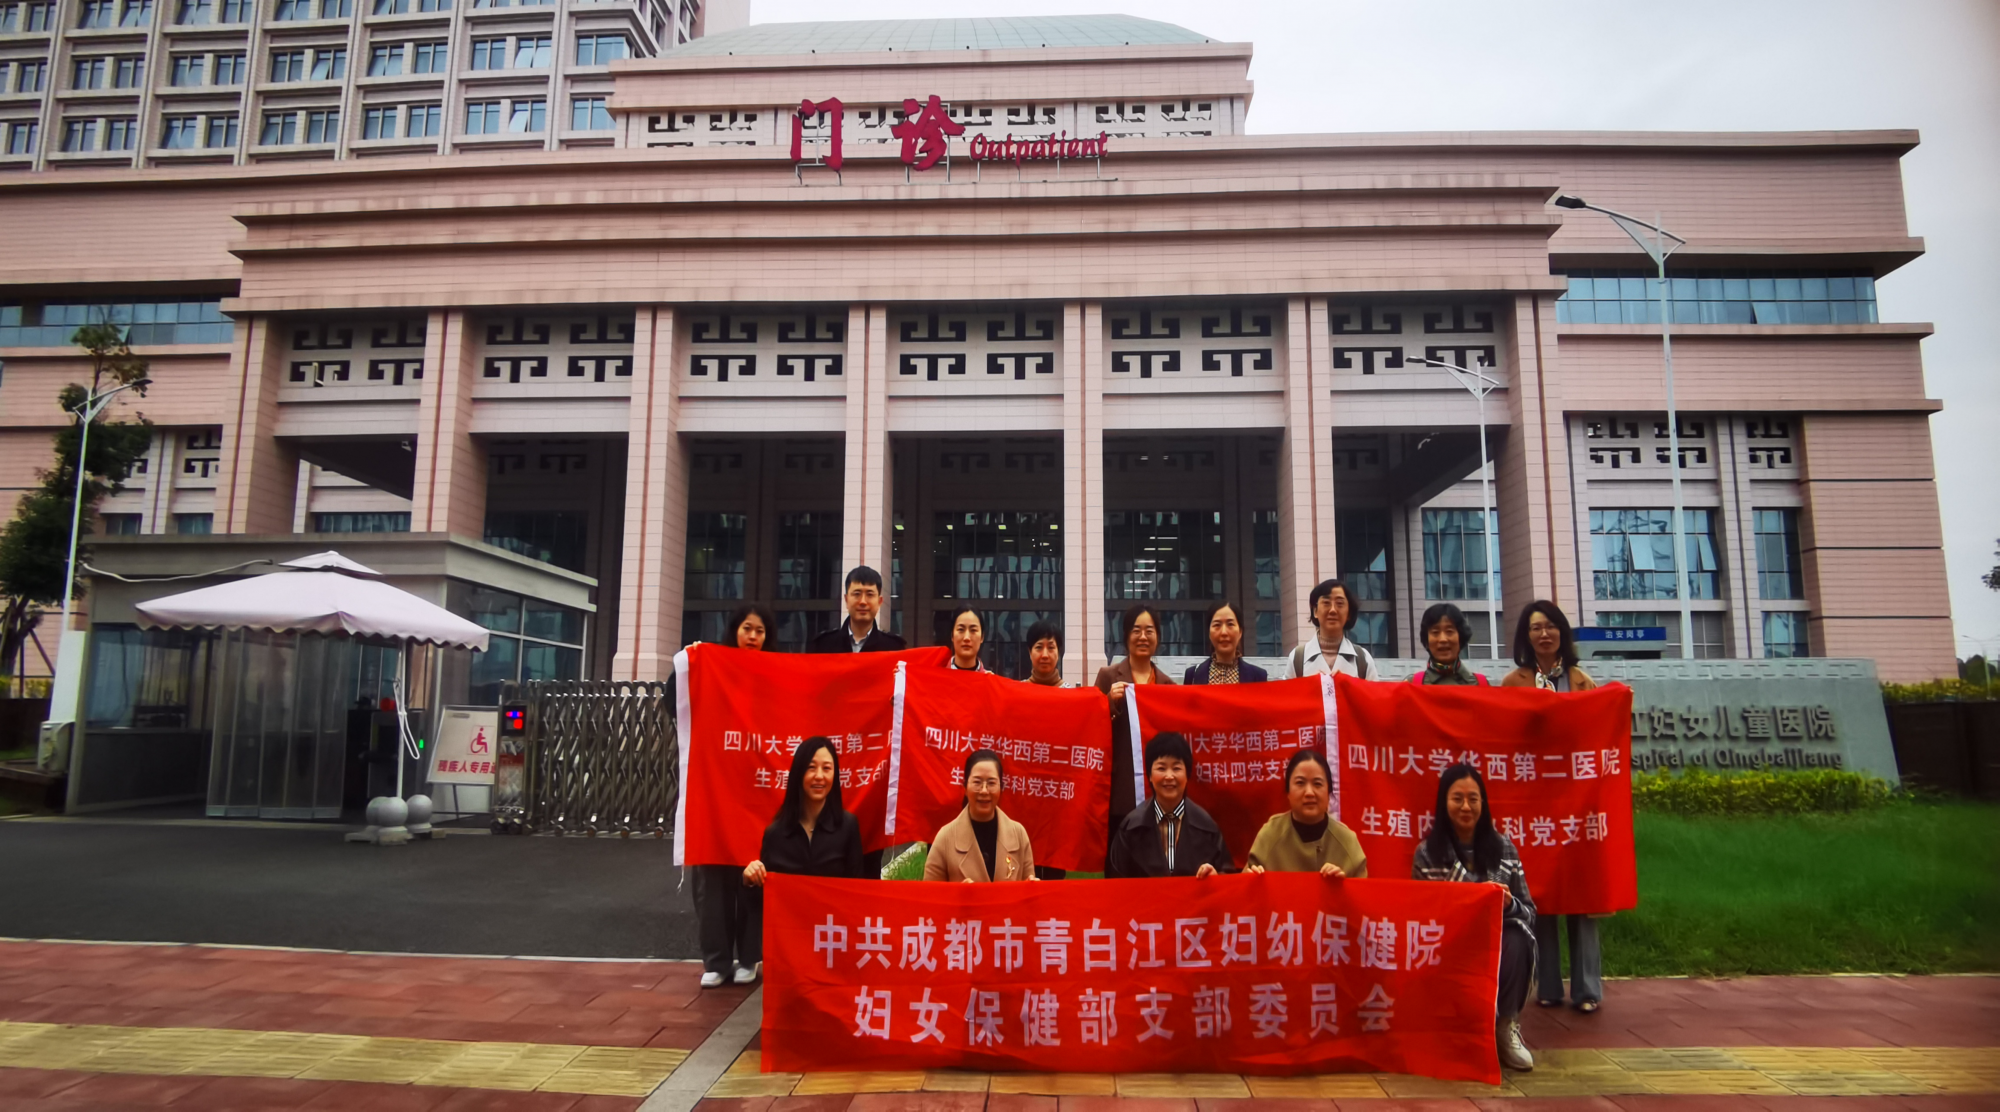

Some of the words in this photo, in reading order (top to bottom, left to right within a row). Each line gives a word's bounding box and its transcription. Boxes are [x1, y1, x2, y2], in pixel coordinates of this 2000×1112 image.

[790, 94, 966, 171] 门诊
[970, 130, 1108, 168] Outpatient
[1604, 629, 1645, 639] 治安岗亭
[925, 726, 1105, 772] 四川大学华西第二医院
[1347, 744, 1621, 782] 四川大学华西第二医院
[1715, 748, 1842, 770] Qingbaijiang
[1360, 805, 1608, 847] 生殖内科党支部
[813, 909, 1445, 976] 中共成都市青白江区妇幼保健院
[853, 981, 1396, 1047] 妇女保健部支部委员会
